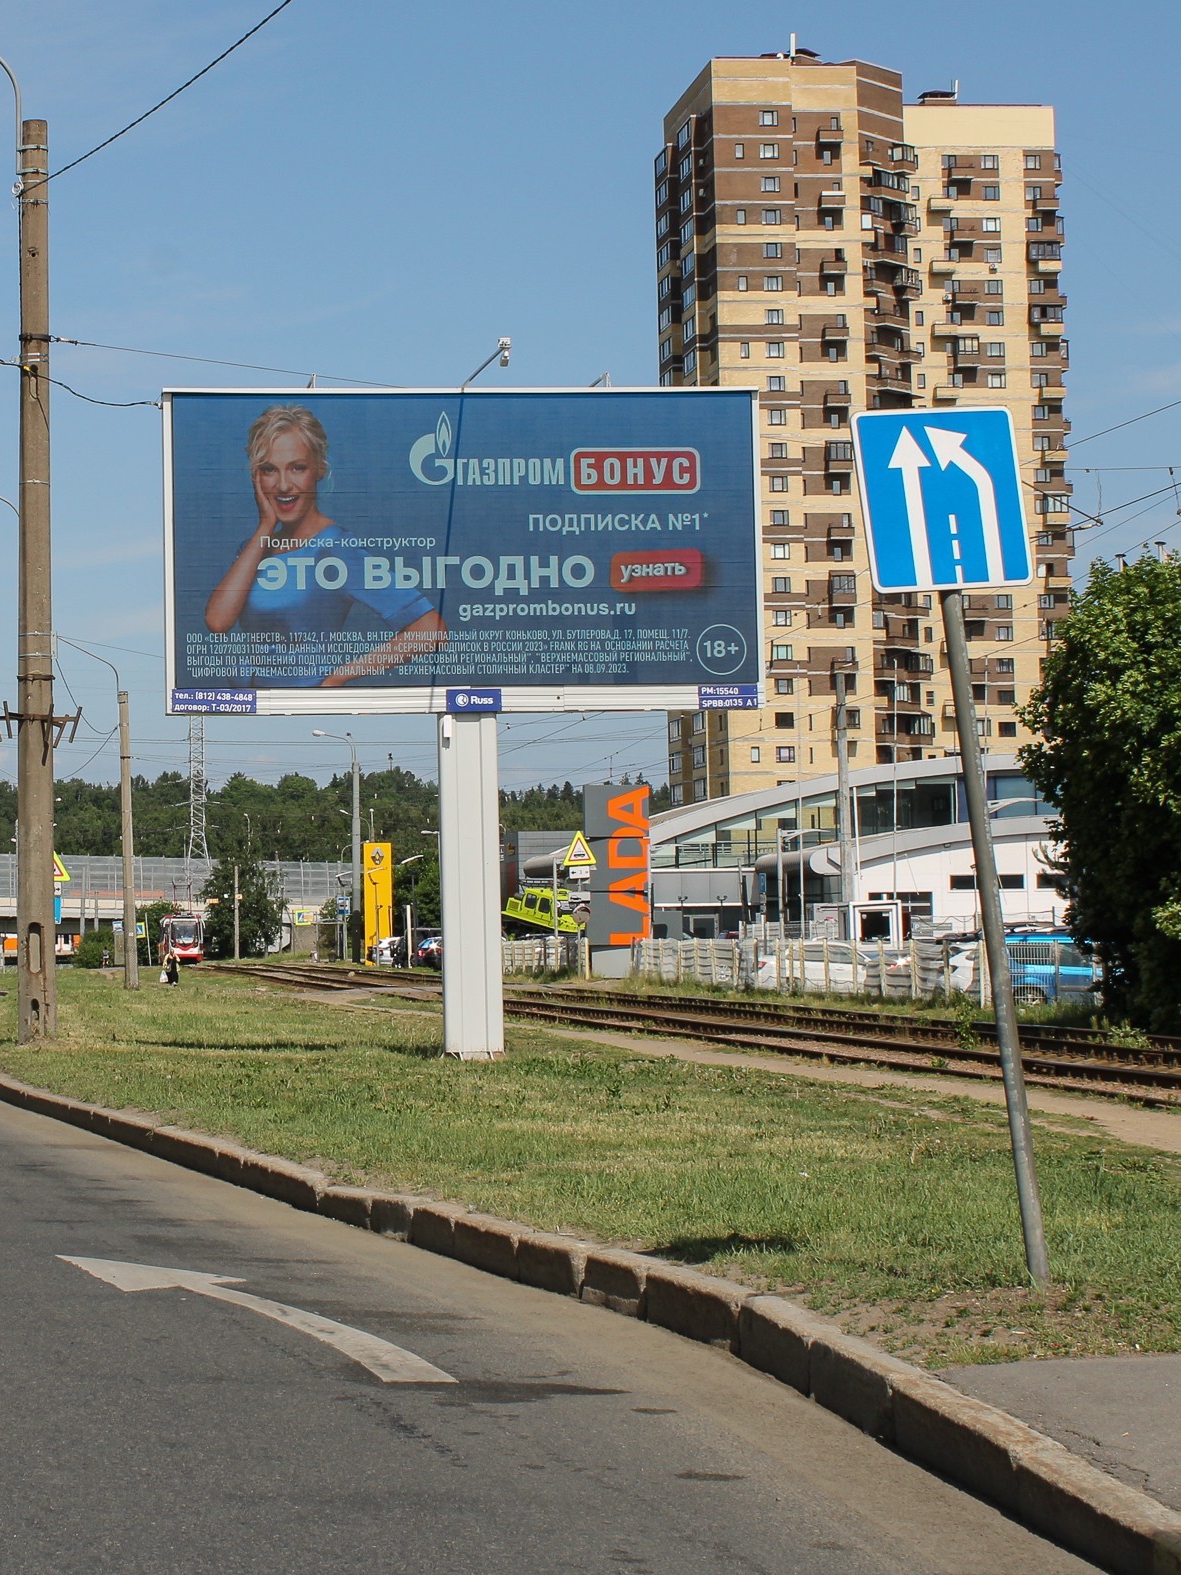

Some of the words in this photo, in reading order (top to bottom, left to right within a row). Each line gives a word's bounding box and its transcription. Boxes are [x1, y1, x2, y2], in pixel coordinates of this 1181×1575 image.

[457, 458, 565, 485] ГАЗПРОМ
[580, 457, 690, 485] БОНУС
[528, 513, 661, 535] ПОДПИСКА
[259, 535, 436, 550] Подписка-конструктор
[257, 556, 349, 591] ЭТО
[364, 555, 595, 596] ВЫГОДНО
[620, 561, 688, 583] узнать
[459, 600, 636, 622] gazprombonus.ru
[186, 632, 203, 643] ООО
[204, 632, 229, 643] «СЕТЬ
[289, 631, 319, 643] 117342,
[404, 629, 477, 642] МУНИЦИПАЛЬНЫЙ
[479, 630, 504, 641] ОКРУГ
[506, 630, 550, 641] КОНЬКОВО,
[552, 630, 563, 640] УЛ.
[637, 629, 670, 641] ПОМЕЩ.
[186, 644, 207, 654] ОГРН
[210, 643, 269, 654] 1207700311060
[289, 643, 325, 654] ДАННЫМ
[327, 642, 391, 654] ИССЛЕДОВАНИЯ
[394, 642, 436, 653] «СЕРВИСЫ
[438, 642, 482, 653] ПОДПИСОК
[483, 641, 489, 652] В
[491, 641, 523, 652] РОССИИ
[549, 641, 576, 651] FRANK
[577, 641, 588, 651] RG
[590, 641, 601, 651] НА
[605, 641, 653, 651] ОСНОВАНИИ
[655, 640, 689, 650] РАСЧЕТА
[703, 640, 739, 657] 18+
[186, 655, 223, 666] ВЫГОДЫ
[225, 655, 237, 666] ПО
[239, 655, 296, 665] НАПОЛНЕНИЮ
[298, 655, 343, 666] ПОДПИСОК
[345, 655, 351, 664] В
[352, 654, 404, 665] КАТЕГОРИЯХ
[240, 665, 317, 677] ВЕРХНЕМАССОВЫЙ
[477, 663, 527, 674] СТОЛИЧНЫЙ
[571, 664, 582, 674] НА
[175, 692, 194, 700] тел.:
[195, 691, 215, 701] (812)
[216, 692, 253, 702] 438-4848
[470, 695, 494, 705] Russ
[174, 704, 209, 713] договор:
[608, 786, 650, 945] LADA
